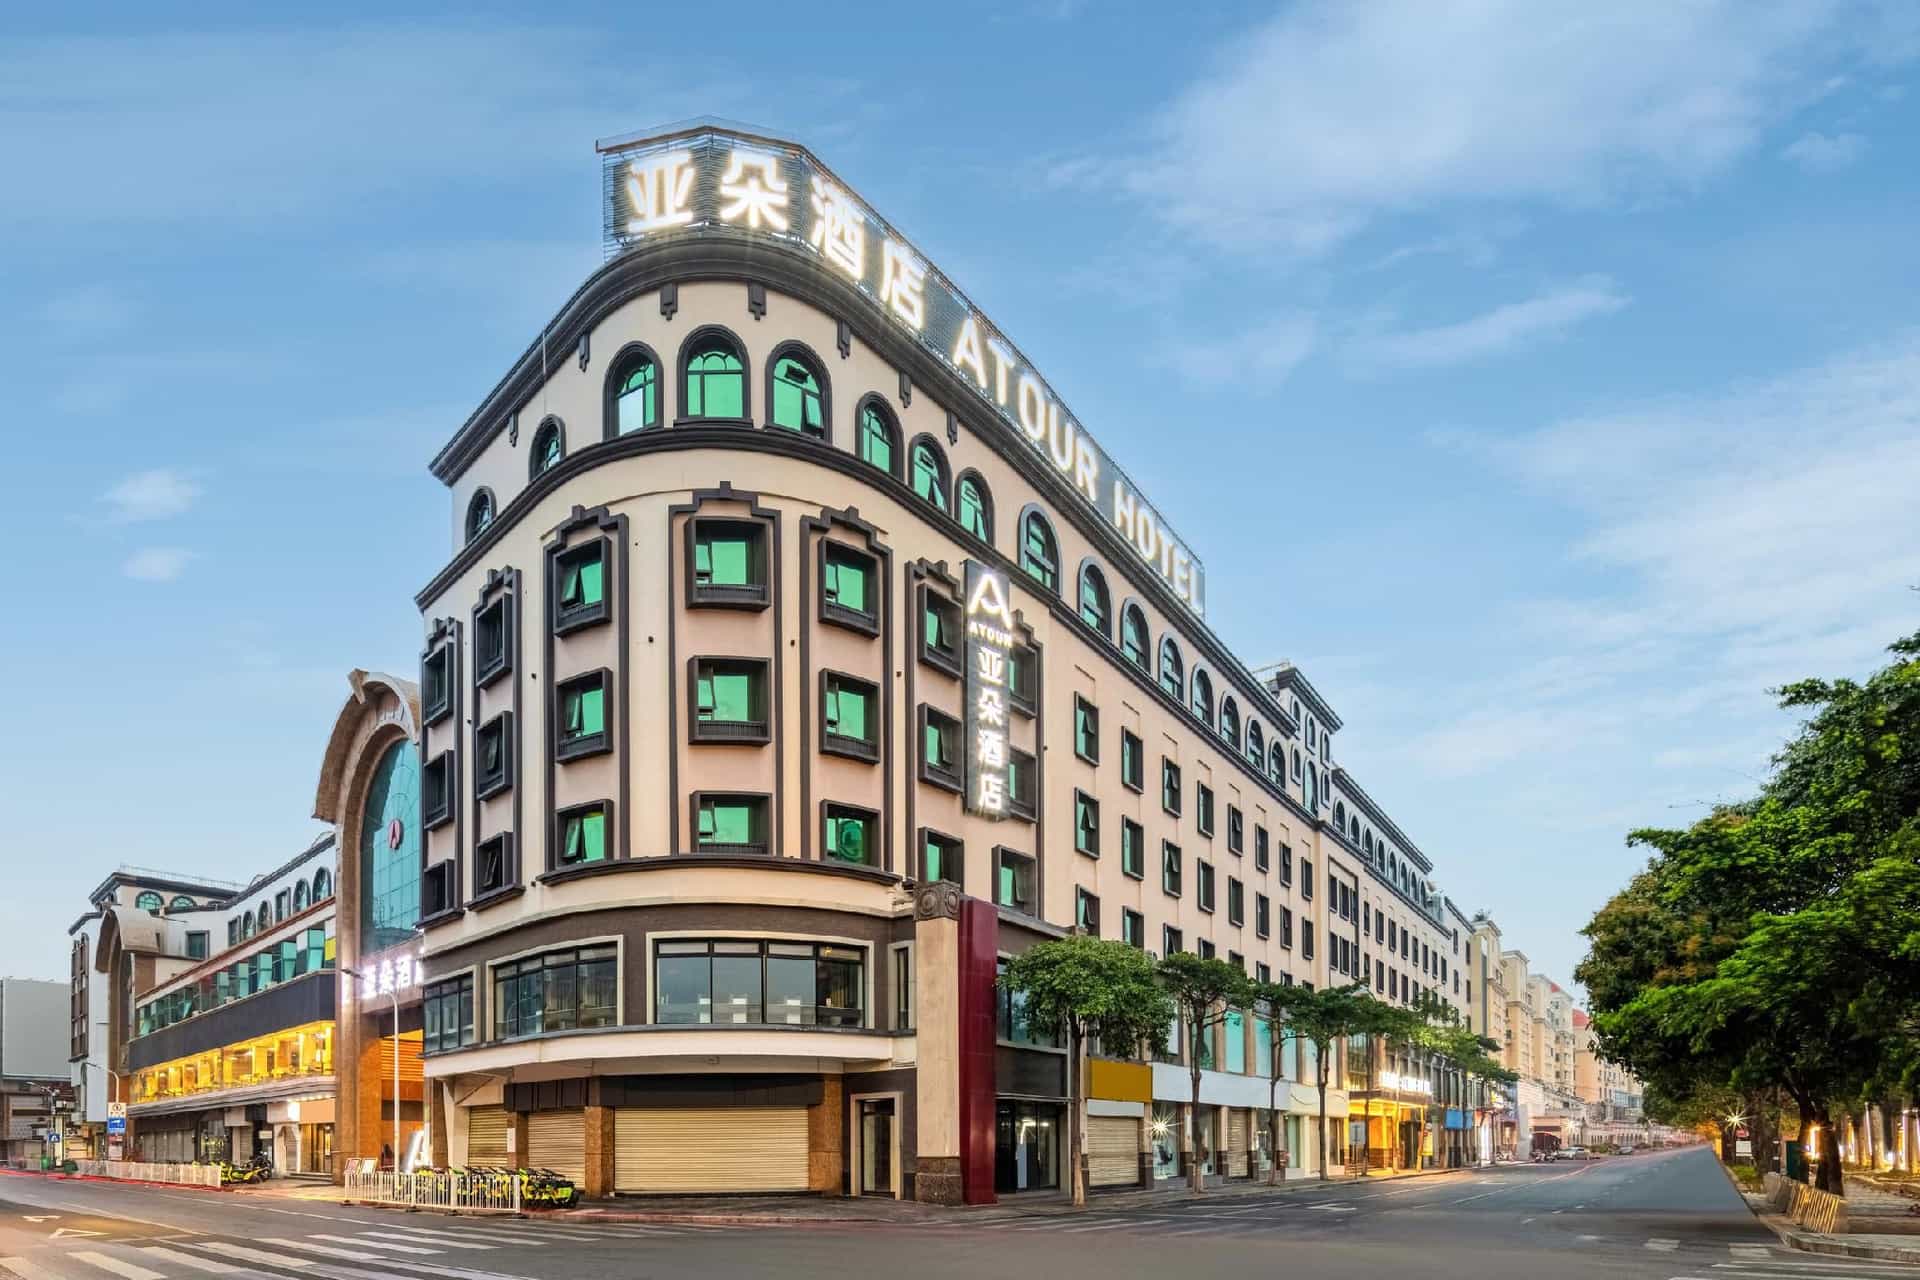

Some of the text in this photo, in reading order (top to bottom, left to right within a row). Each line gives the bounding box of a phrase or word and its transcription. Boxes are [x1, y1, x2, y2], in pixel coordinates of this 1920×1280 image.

[626, 149, 927, 331] 亚朵酒店
[953, 317, 1204, 614] ATOUR HOTEL
[978, 646, 1003, 811] 亚朵酒店
